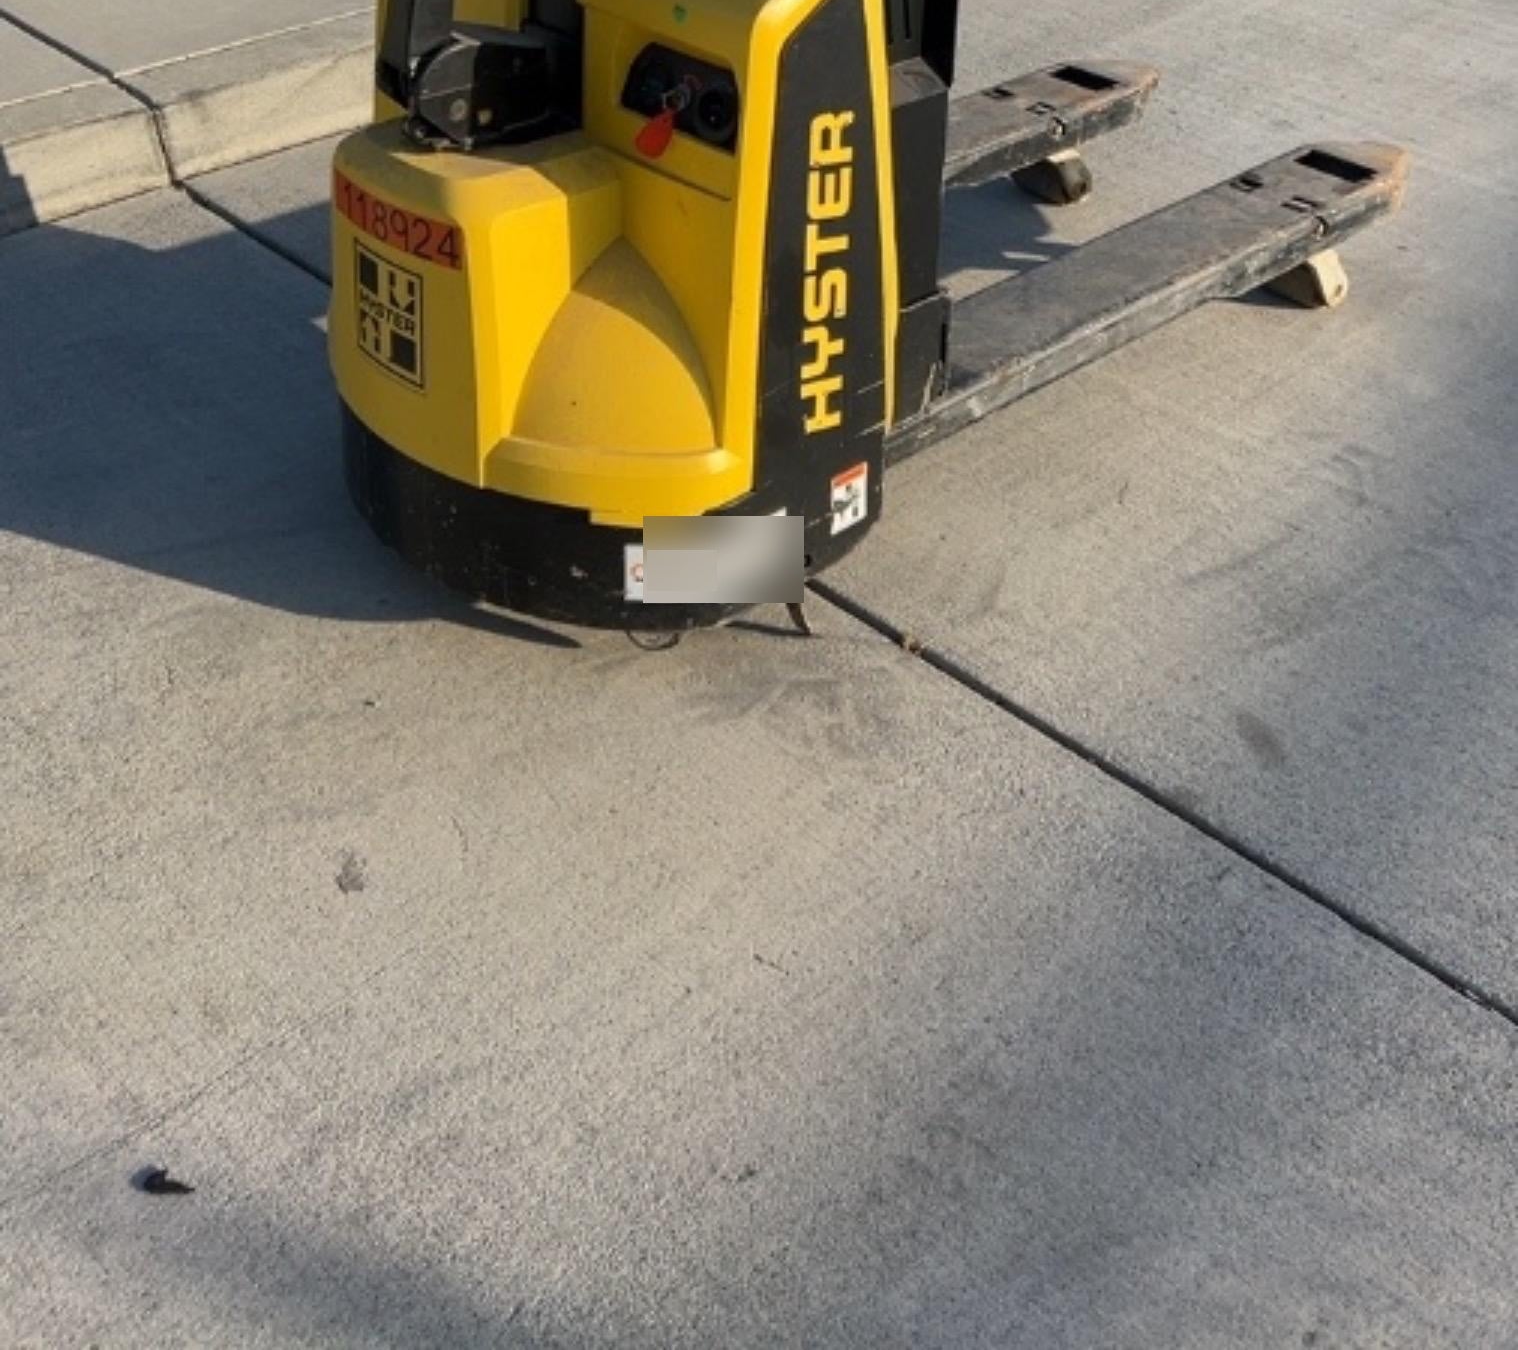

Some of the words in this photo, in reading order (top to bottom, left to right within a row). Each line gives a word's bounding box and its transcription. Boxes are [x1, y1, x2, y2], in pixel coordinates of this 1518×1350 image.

[343, 183, 459, 265] 118924
[359, 290, 415, 337] HYSTER
[801, 110, 855, 436] HYSTER
